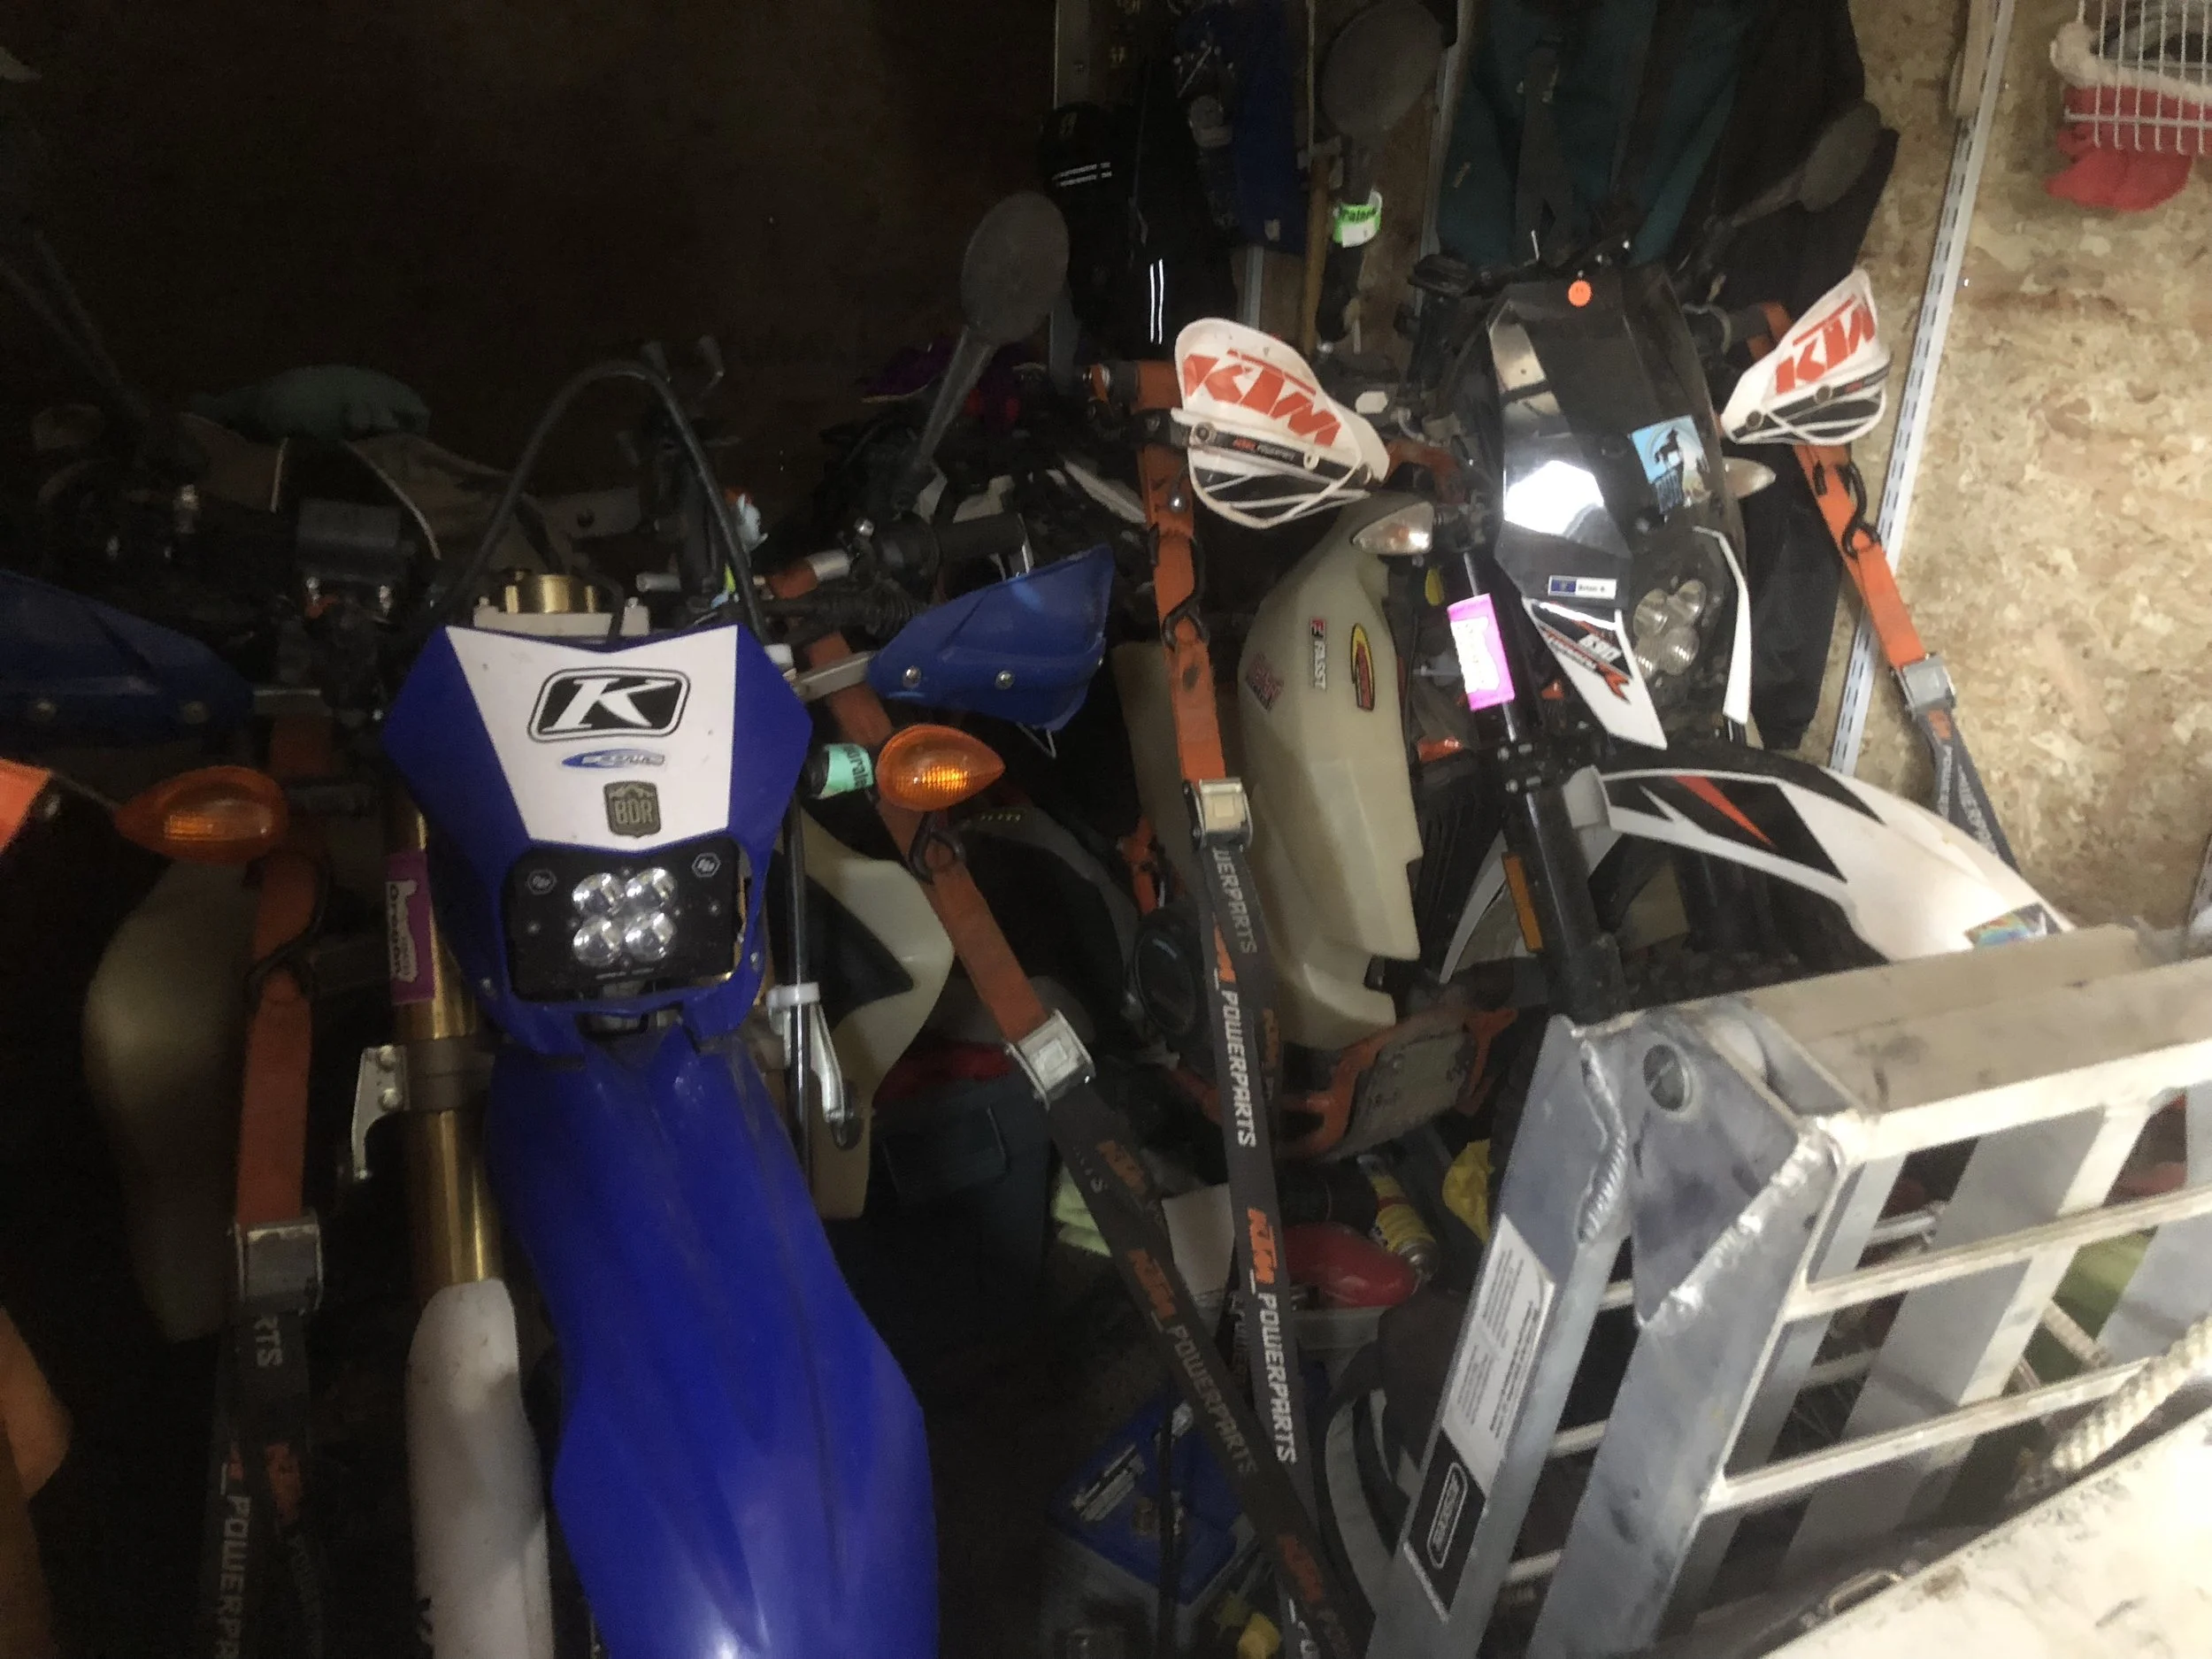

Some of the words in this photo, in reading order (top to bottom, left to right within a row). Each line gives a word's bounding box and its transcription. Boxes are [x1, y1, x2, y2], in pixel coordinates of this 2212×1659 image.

[1776, 295, 1876, 395] KTM
[1182, 349, 1341, 448] KTM
[541, 678, 677, 733] K
[614, 798, 654, 825] BDR
[1221, 988, 1257, 1148] POWERPARTS
[1257, 1292, 1298, 1464] POWERPARTS
